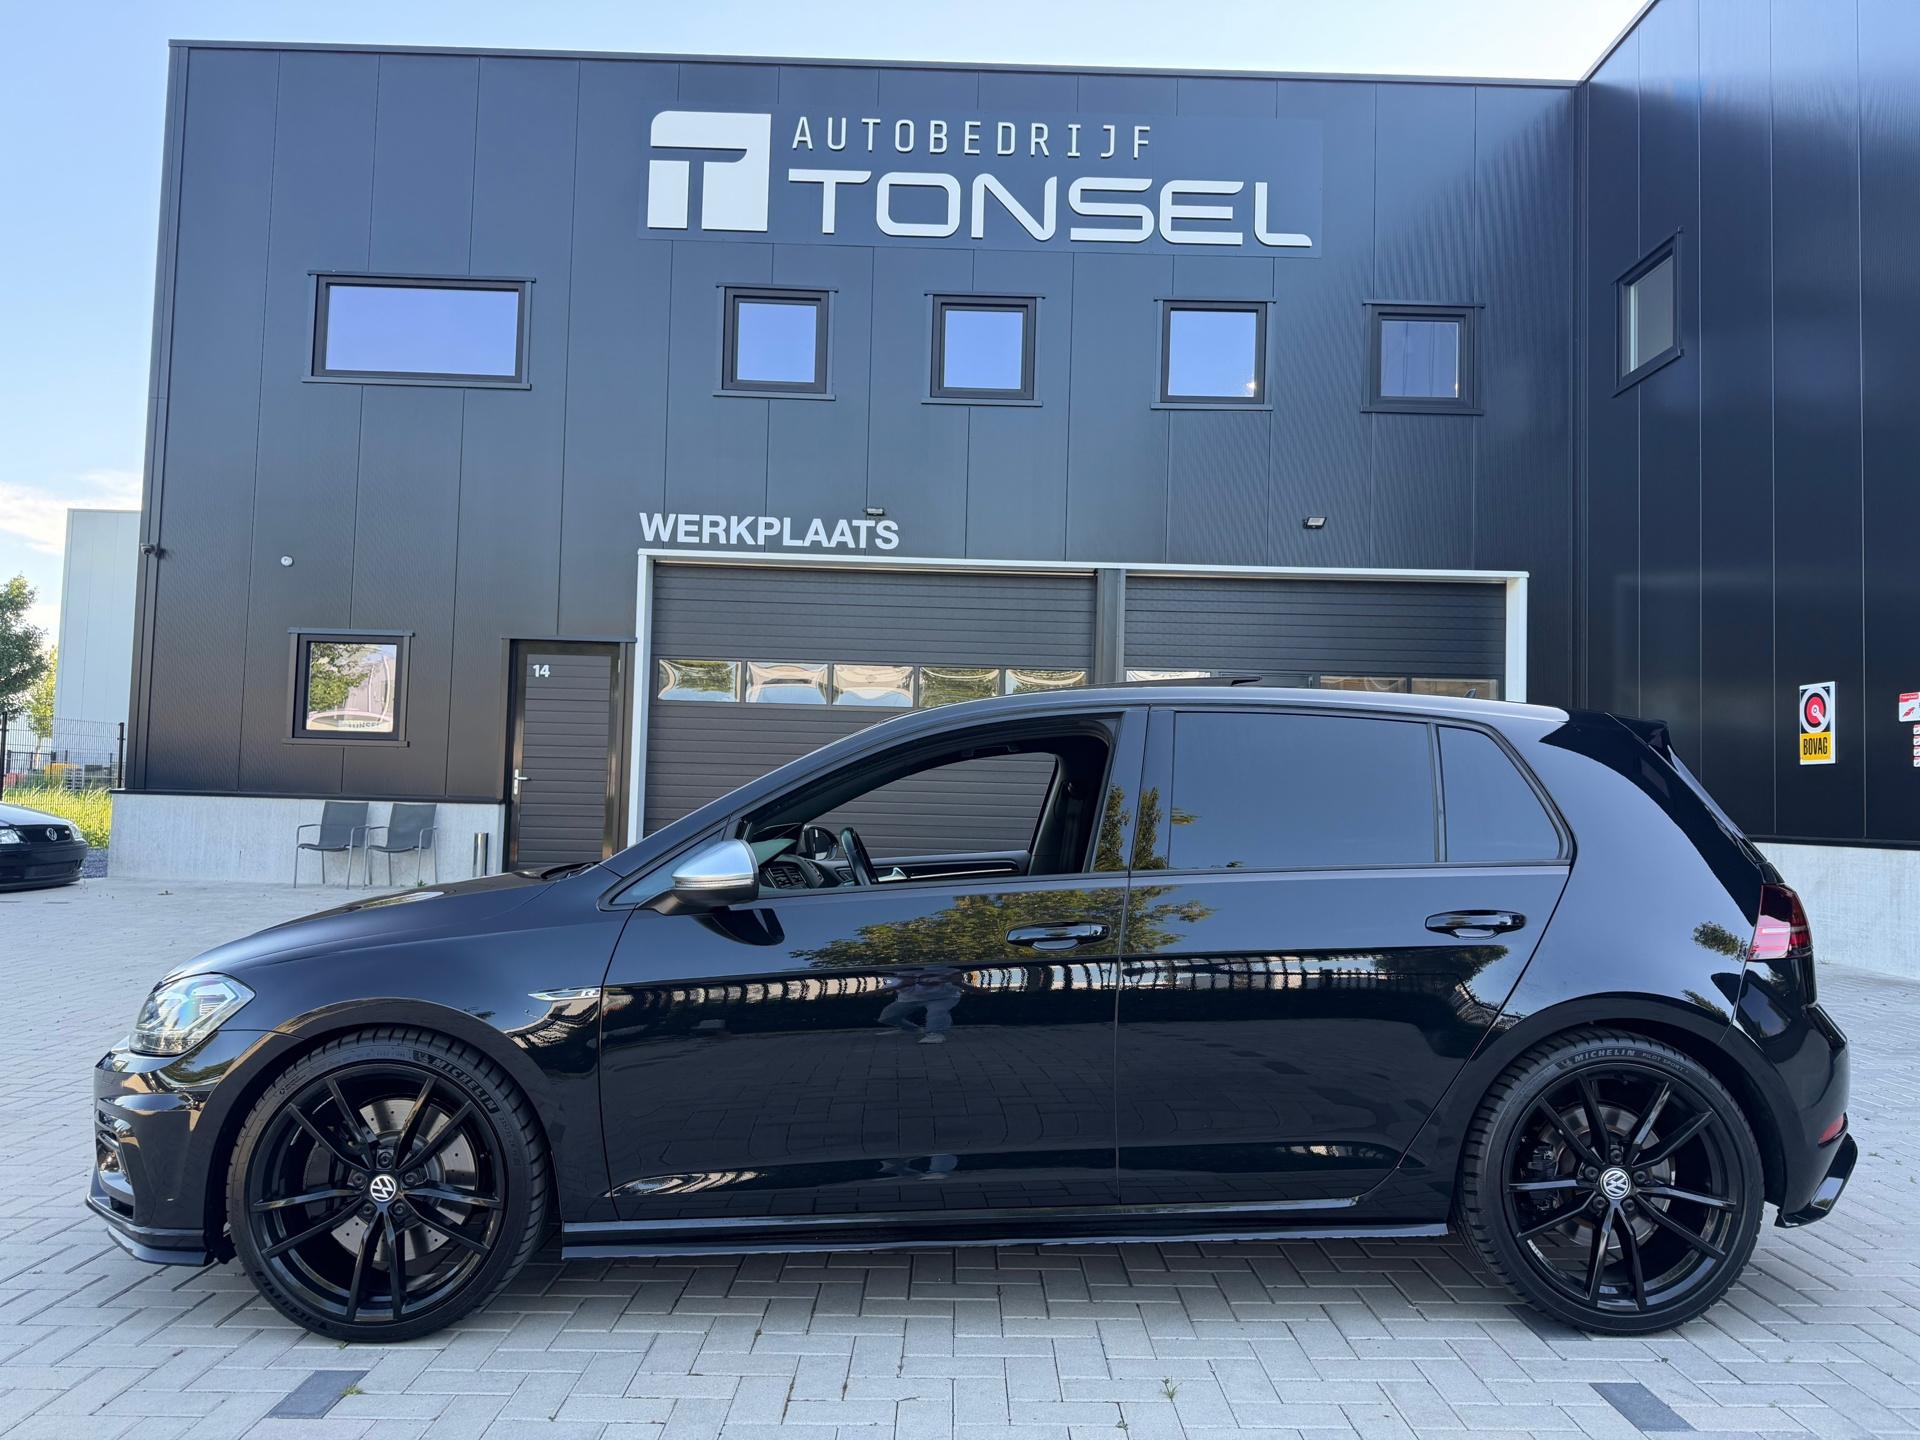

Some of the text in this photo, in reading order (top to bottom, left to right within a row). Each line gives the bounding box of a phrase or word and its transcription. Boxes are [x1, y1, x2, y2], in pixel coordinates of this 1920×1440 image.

[792, 116, 1151, 158] AUTOBEDRIJF
[789, 169, 1312, 247] TONSEL
[639, 512, 899, 550] WERKPLAATS
[532, 664, 551, 678] 14
[1803, 737, 1828, 755] BOVAG
[1574, 1049, 1636, 1062] MICHELIN
[434, 1059, 499, 1112] MICHELIN
